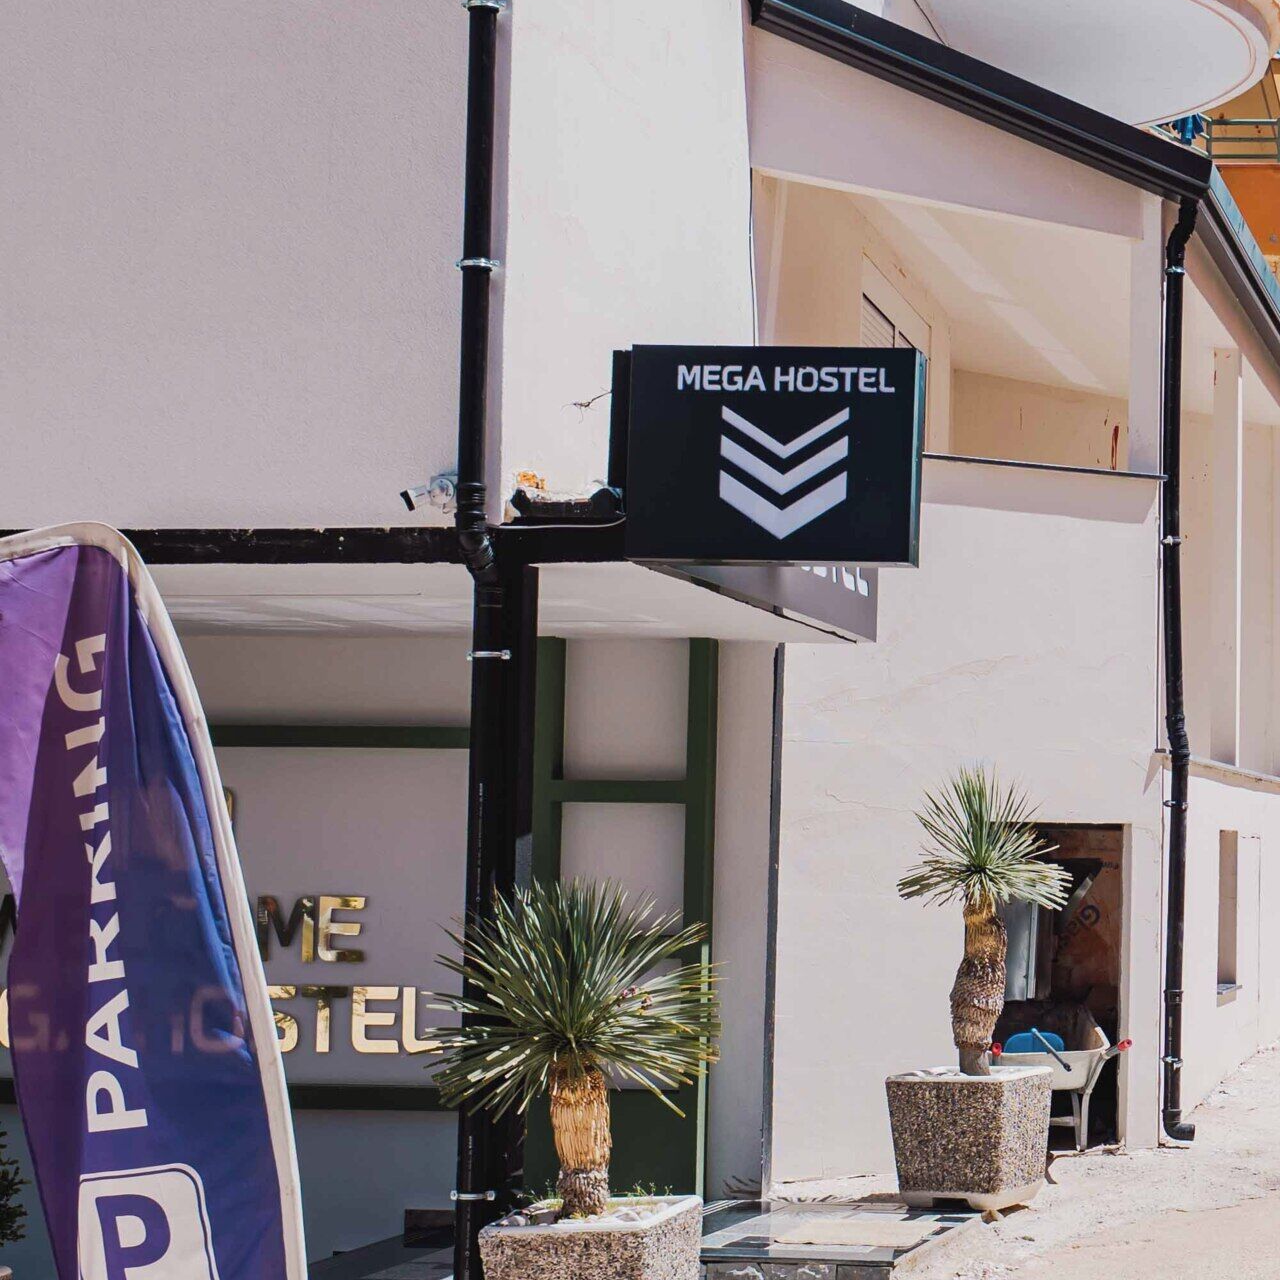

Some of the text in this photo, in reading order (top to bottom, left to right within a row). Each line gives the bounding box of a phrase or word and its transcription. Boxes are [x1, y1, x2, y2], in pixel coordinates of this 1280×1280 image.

[676, 365, 896, 393] MEGA HOSTEL
[54, 633, 148, 1133] PARKING
